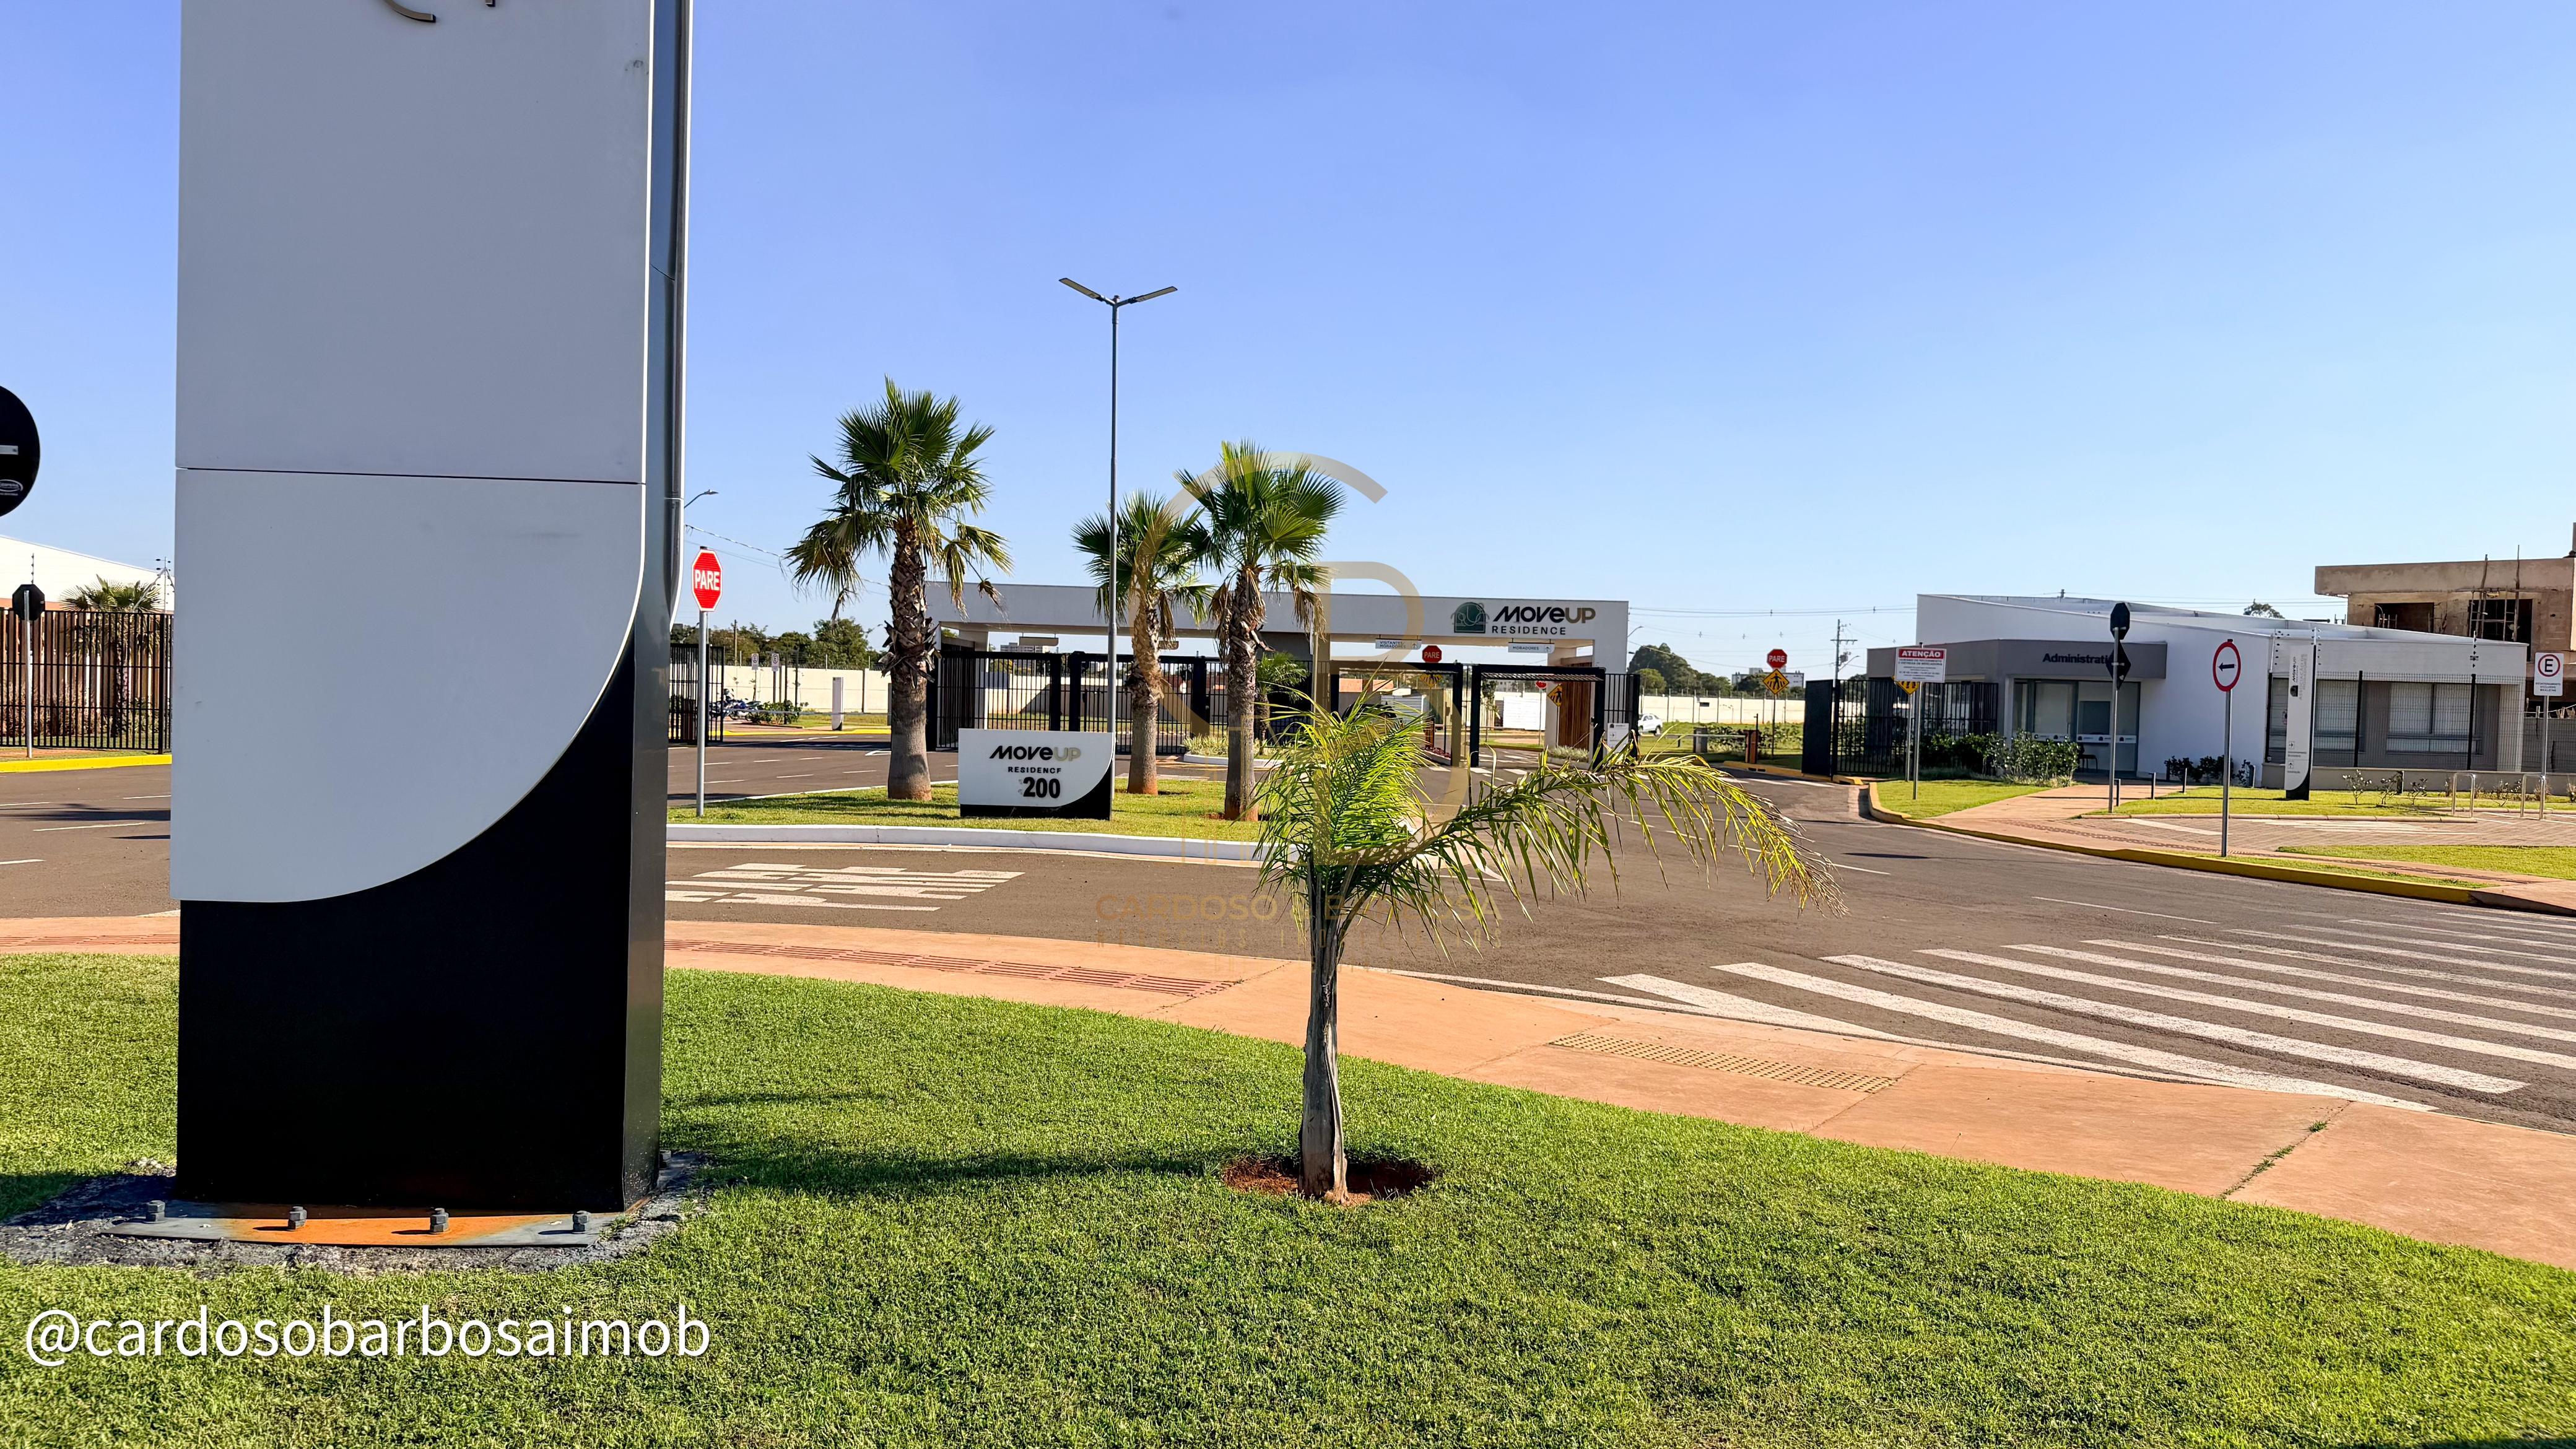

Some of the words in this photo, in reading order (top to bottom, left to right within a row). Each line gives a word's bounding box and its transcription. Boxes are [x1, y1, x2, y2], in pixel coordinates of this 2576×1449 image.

[695, 569, 720, 591] PARE
[1492, 626, 1566, 635] RESIDENCE
[2544, 659, 2554, 672] E
[1023, 777, 1061, 798] 200
